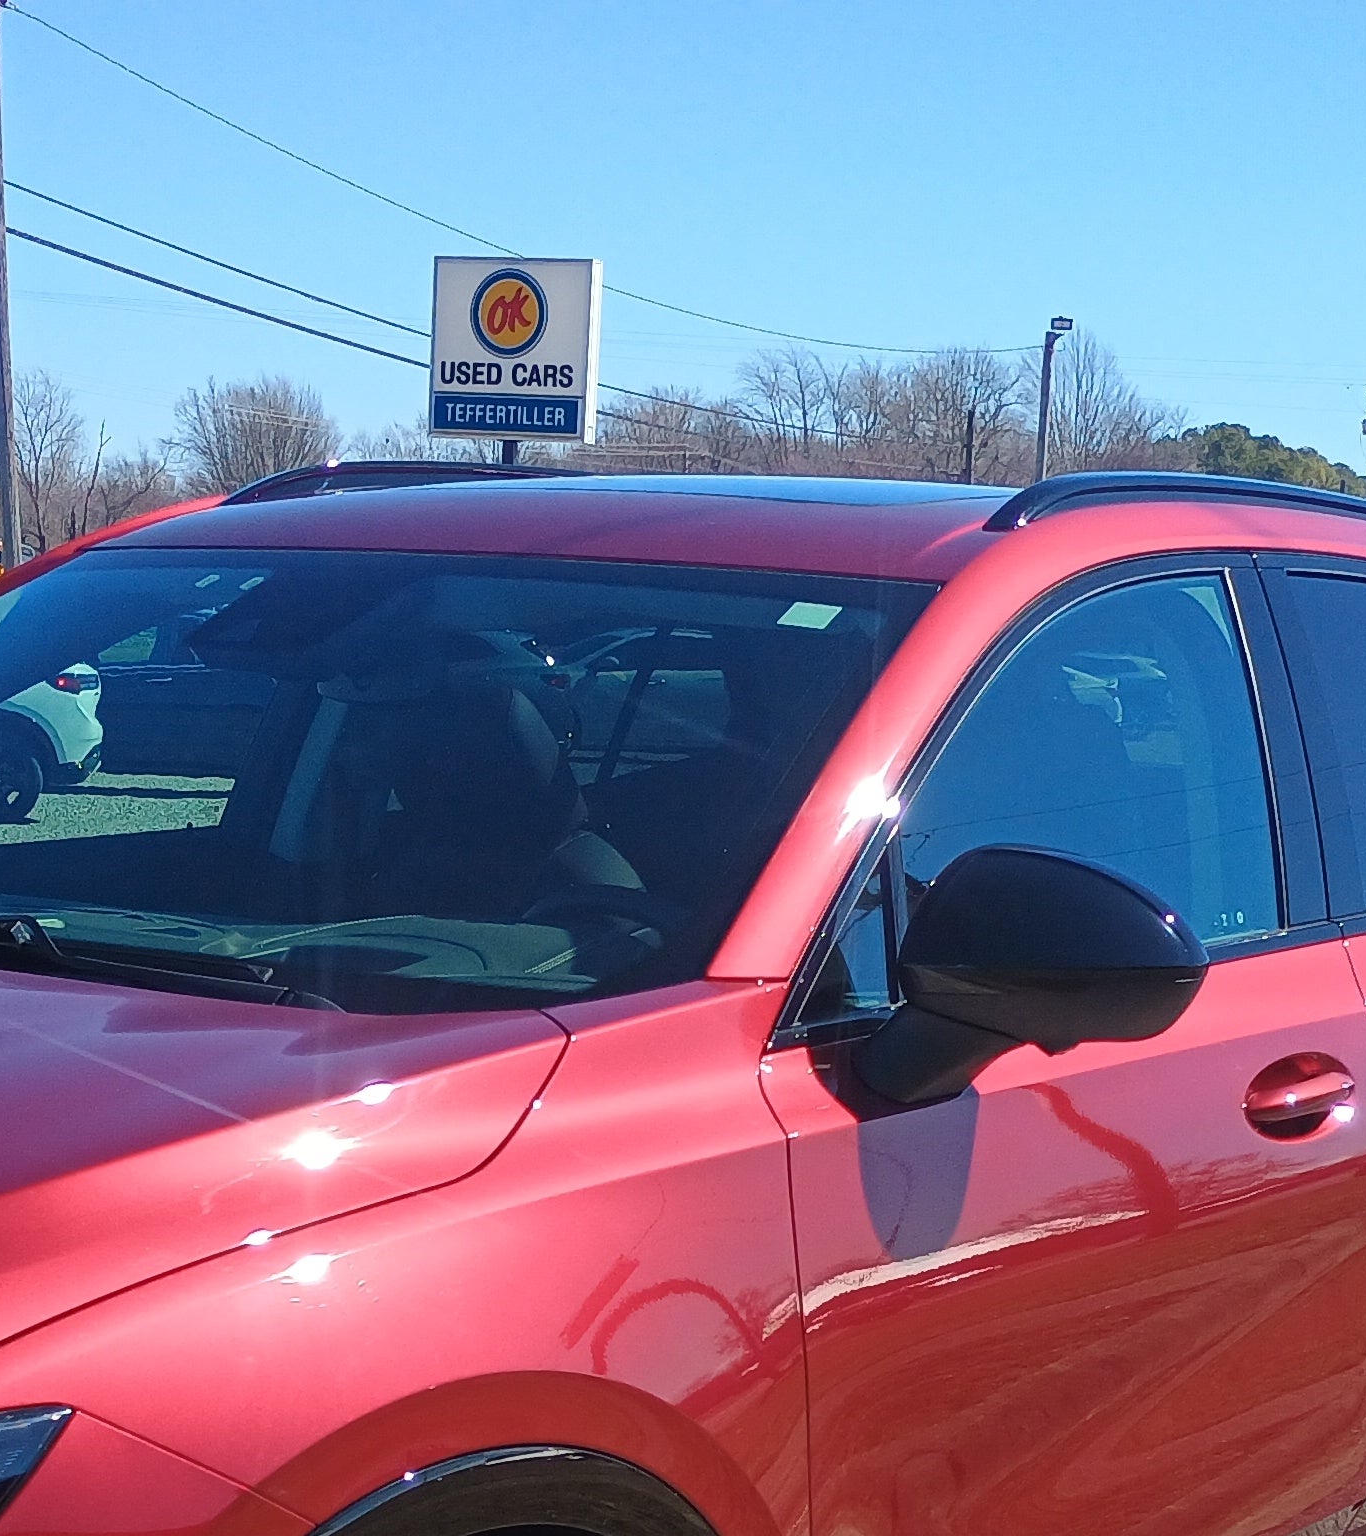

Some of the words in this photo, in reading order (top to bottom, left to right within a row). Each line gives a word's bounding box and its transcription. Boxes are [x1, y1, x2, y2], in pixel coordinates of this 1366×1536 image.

[486, 286, 531, 335] OK
[440, 361, 502, 385] USED
[512, 364, 573, 388] CARS
[446, 403, 565, 426] TEFFERTILLER
